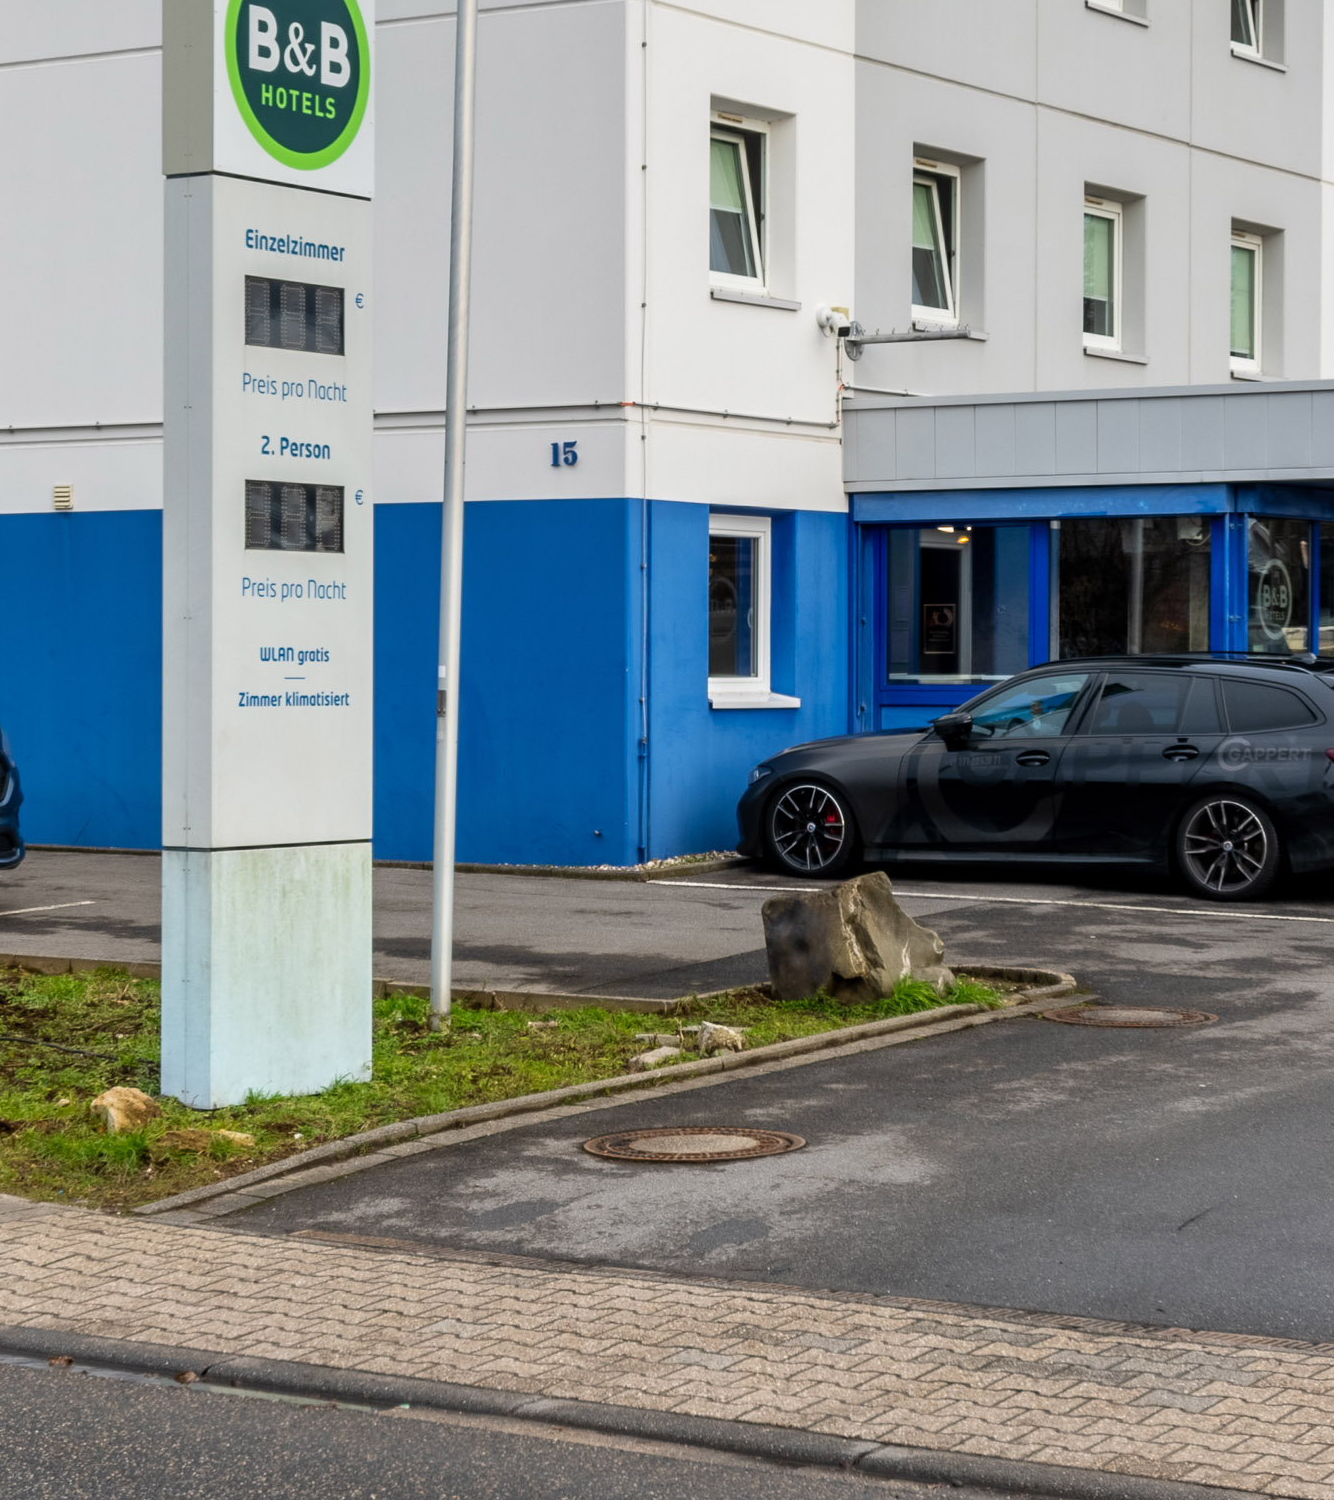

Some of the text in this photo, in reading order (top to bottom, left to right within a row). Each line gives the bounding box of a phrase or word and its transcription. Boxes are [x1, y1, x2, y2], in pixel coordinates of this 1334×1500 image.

[248, 3, 351, 88] B&B
[261, 83, 337, 119] HOTELS
[245, 228, 346, 262] Einzelzimmer
[242, 372, 348, 402] Preis pro Nacht
[261, 435, 331, 460] 2. Person
[550, 440, 579, 468] 15
[242, 577, 347, 602] Preis pro Nacht
[1263, 584, 1288, 609] B&B
[259, 646, 330, 666] WLAN gratis
[238, 691, 350, 707] Zimmer klimatisiert
[1228, 747, 1313, 762] GAPPERT
